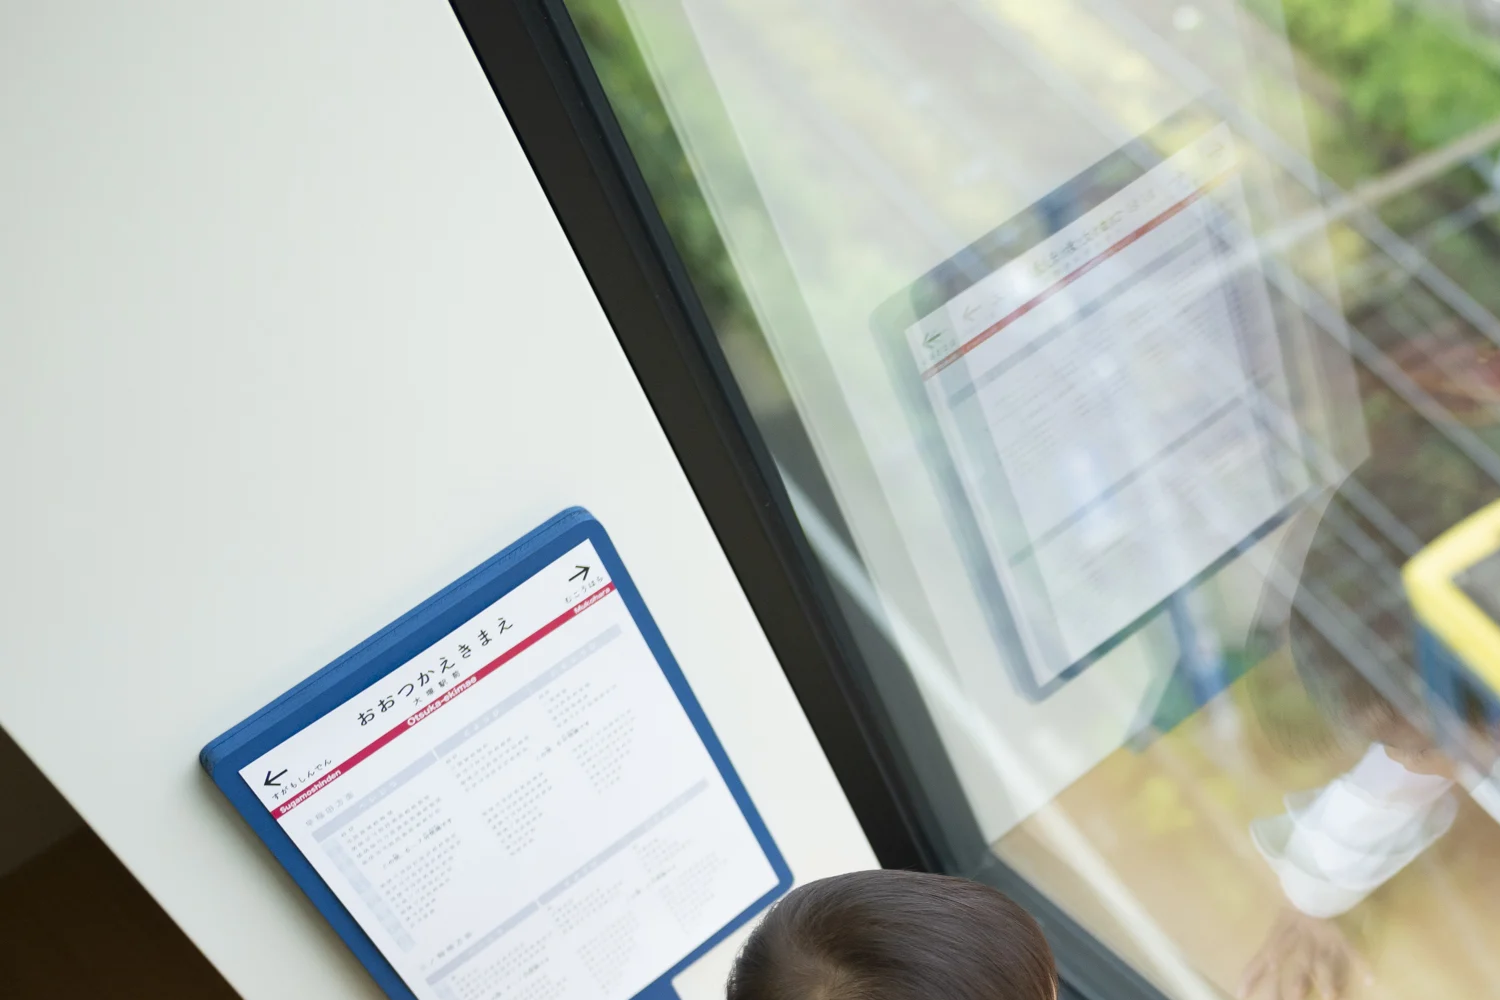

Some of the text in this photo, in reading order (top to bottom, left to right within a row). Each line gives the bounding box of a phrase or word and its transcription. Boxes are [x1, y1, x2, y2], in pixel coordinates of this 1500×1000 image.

[357, 617, 513, 726] おおつかえきまえ
[412, 670, 461, 706] 大塚駅前
[407, 676, 477, 726] Otsuka-ekimae
[271, 759, 332, 800] すがもしんでん
[279, 769, 341, 813] Sugamoshinden
